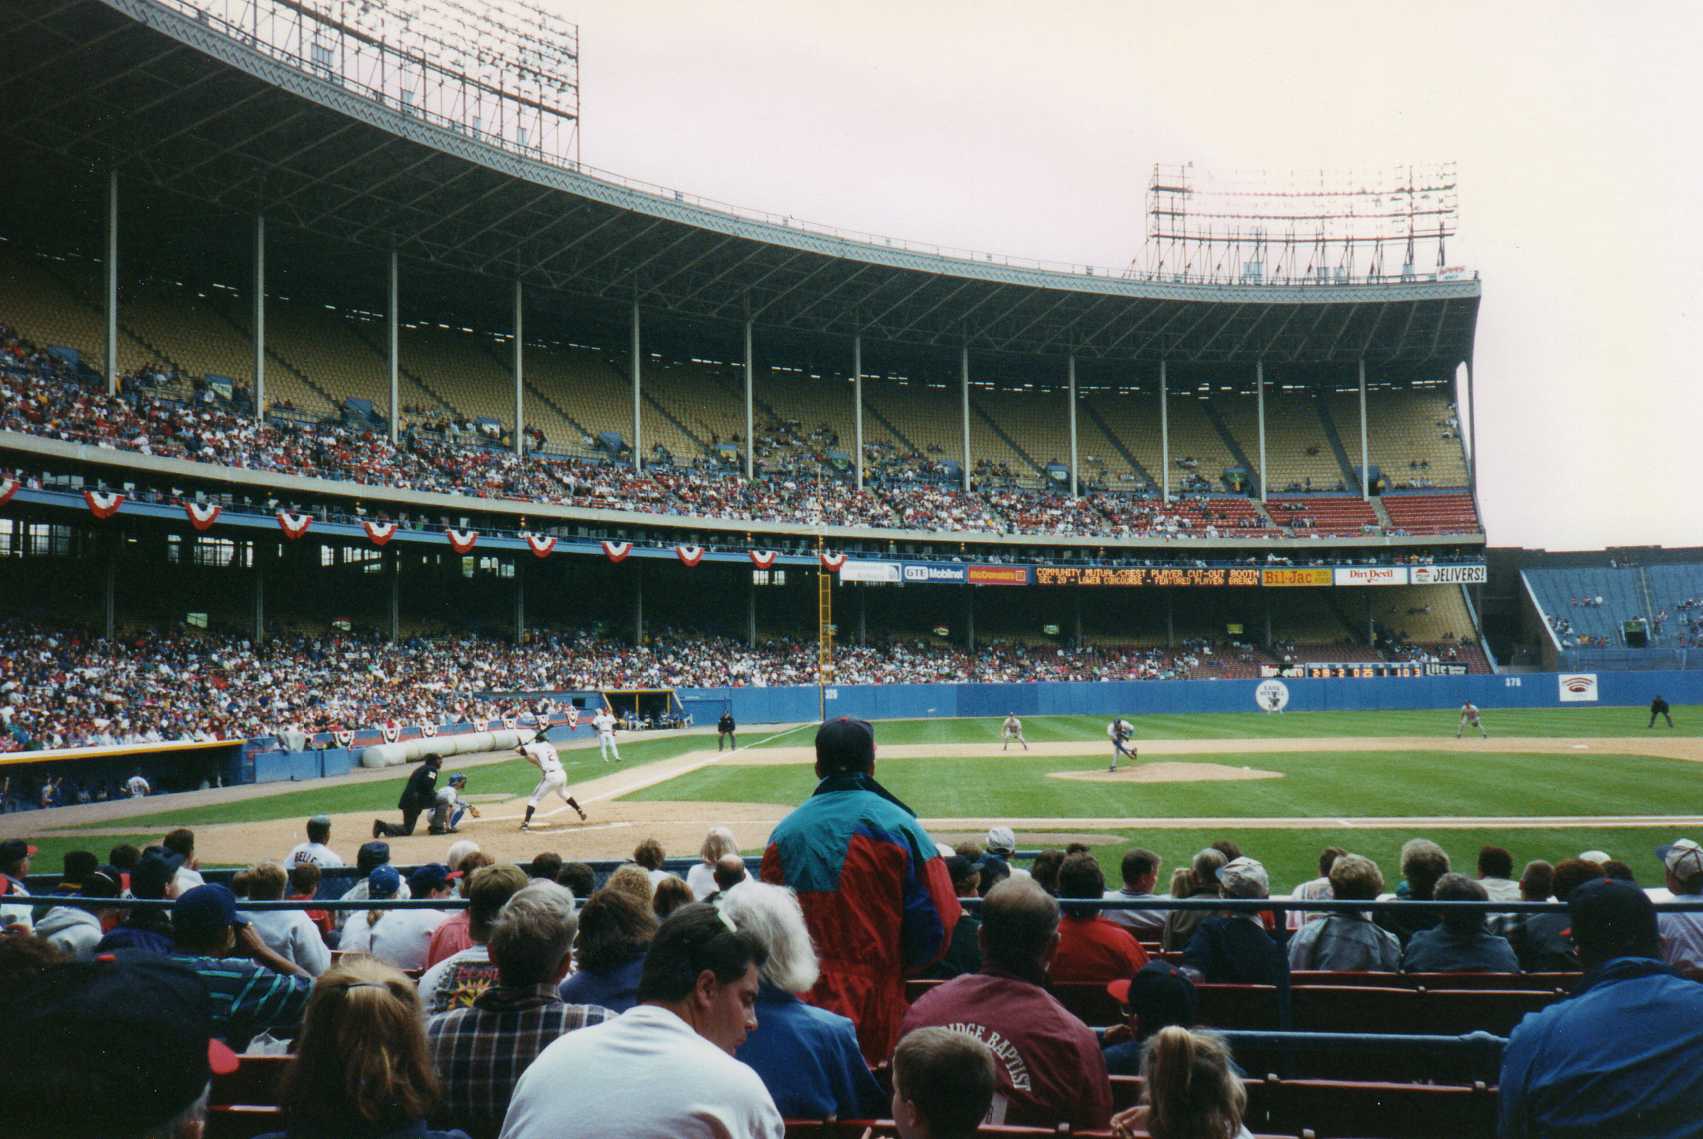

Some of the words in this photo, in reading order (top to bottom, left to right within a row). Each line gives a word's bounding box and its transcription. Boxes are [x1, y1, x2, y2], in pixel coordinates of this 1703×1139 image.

[906, 568, 927, 577] GTE
[1036, 568, 1081, 577] COMMUNITY
[1188, 570, 1225, 578] CUT-OUT
[1230, 570, 1259, 578] BOOTH
[1369, 569, 1393, 578] Devil
[1433, 567, 1485, 582] DELIVERS!
[1078, 577, 1101, 585] LOWER
[986, 1031, 1032, 1092] BAPTIST
